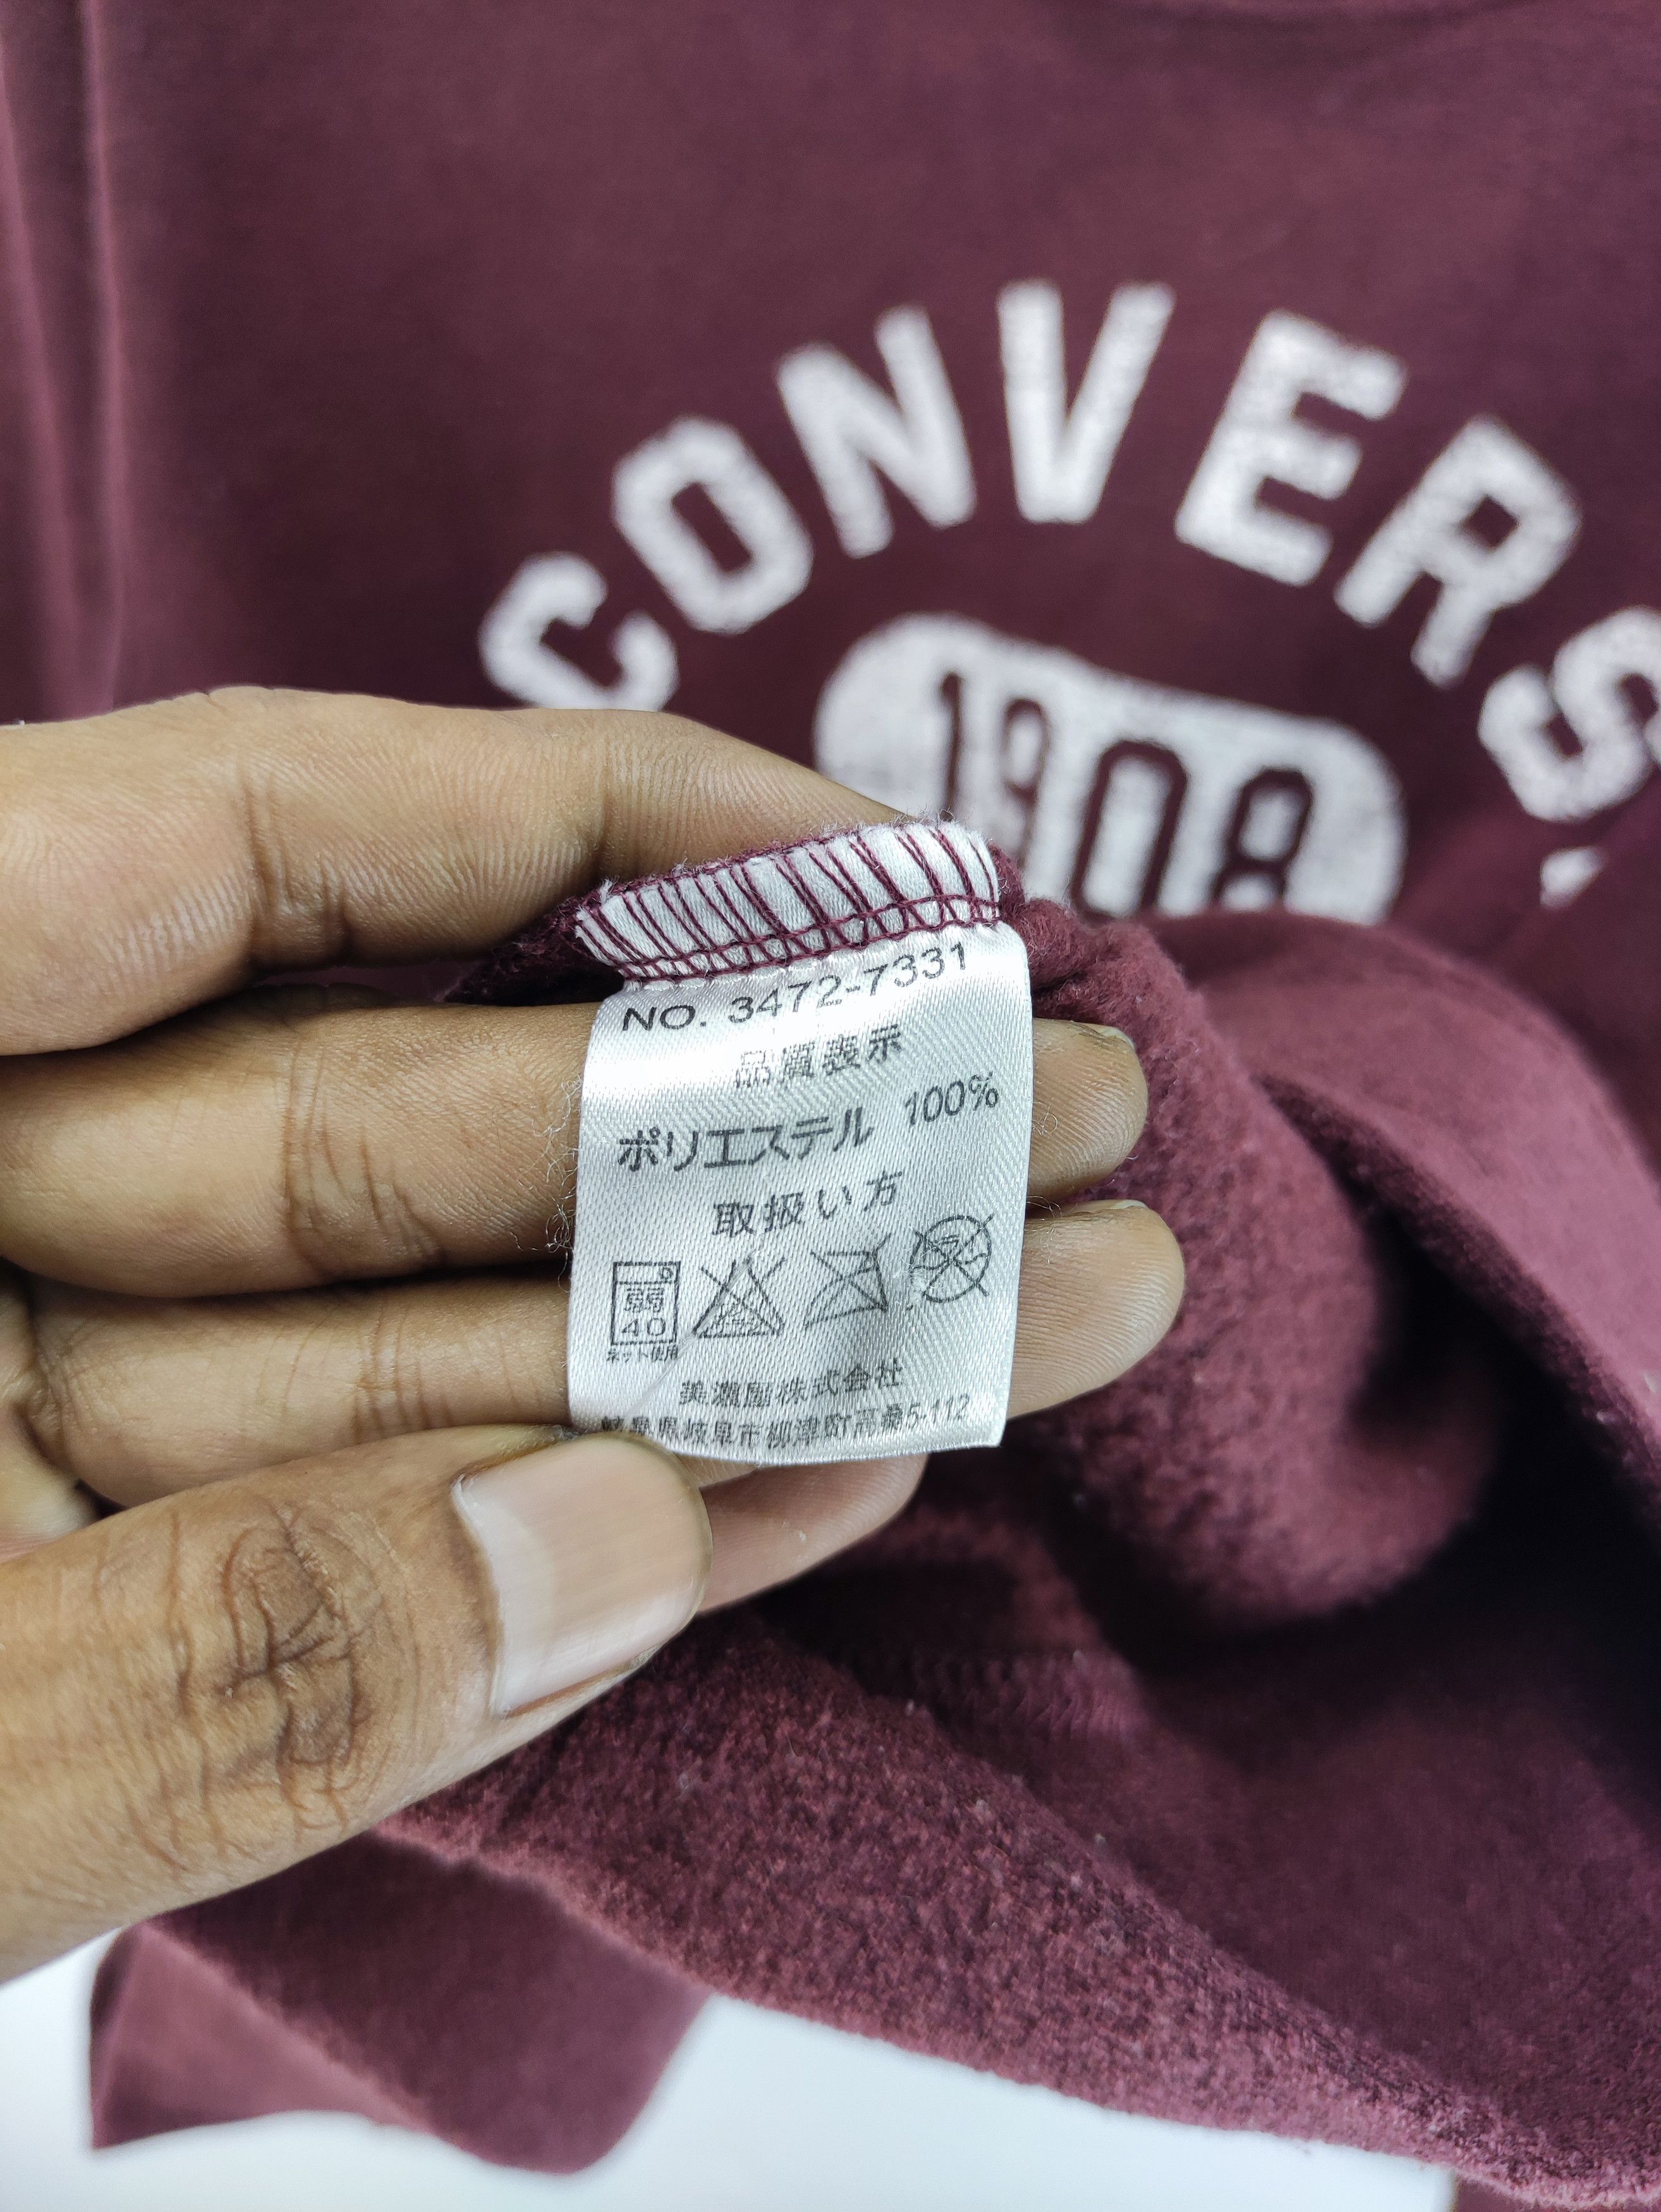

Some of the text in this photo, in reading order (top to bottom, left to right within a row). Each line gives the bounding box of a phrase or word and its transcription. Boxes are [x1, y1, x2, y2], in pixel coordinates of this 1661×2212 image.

[479, 281, 1661, 910] CONVERS
[622, 941, 968, 1031] NO. 3472-7331
[733, 1023, 901, 1088] 品質表示
[618, 1071, 1000, 1172] ポリエステル 100%
[712, 1170, 903, 1238] 取扱い方
